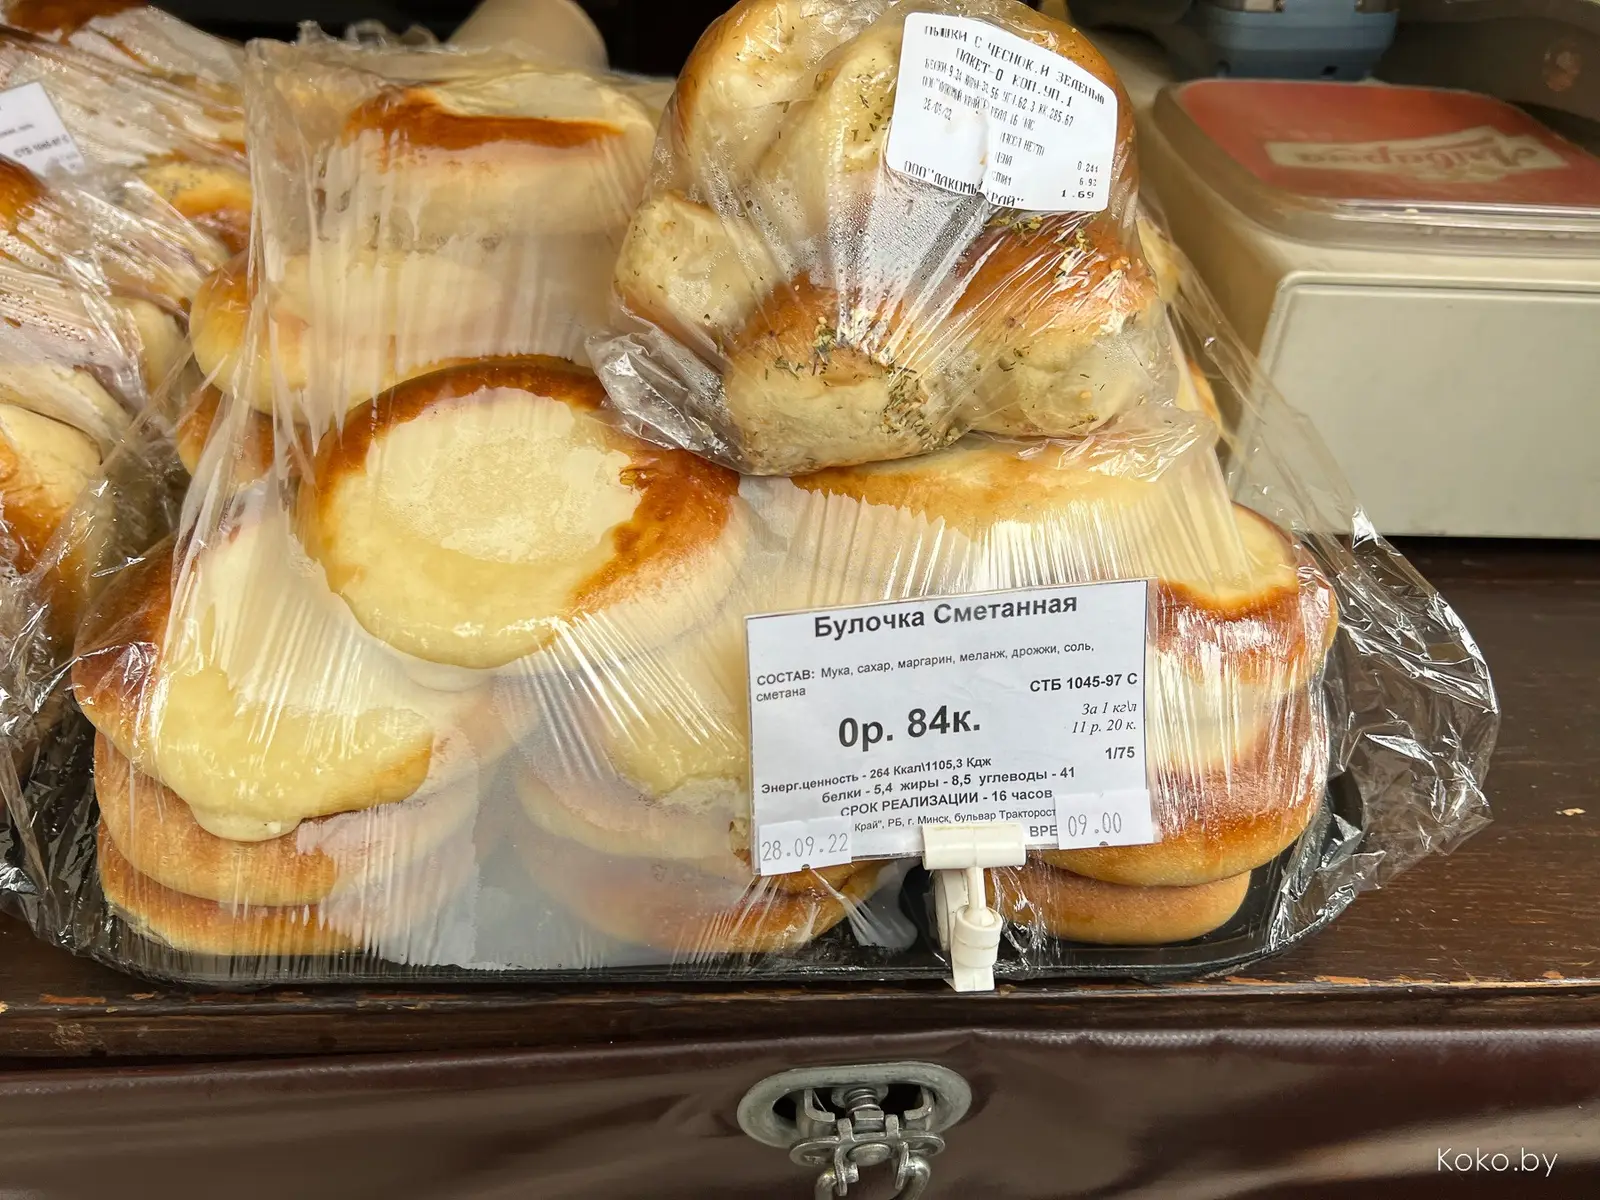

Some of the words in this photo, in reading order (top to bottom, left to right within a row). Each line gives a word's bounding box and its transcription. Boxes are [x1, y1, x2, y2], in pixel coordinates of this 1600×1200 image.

[924, 25, 968, 42] ПЫШКИ
[974, 35, 983, 49] С
[1056, 71, 1105, 105] ЗЕЛЕНЬЮ
[1061, 188, 1095, 199] 1.69
[814, 610, 925, 641] Булочка
[933, 596, 1078, 624] Сметанная
[756, 669, 815, 686] СОСТАВ:
[820, 667, 854, 680] Мука,
[857, 662, 894, 674] сахар,
[897, 654, 956, 669] маргарин,
[959, 650, 1008, 662] меланж,
[1011, 645, 1060, 658] дрожжи,
[1063, 641, 1094, 653] соль,
[756, 687, 806, 702] сметана
[1029, 678, 1062, 692] СТБ
[1066, 673, 1122, 690] 1045-97
[1126, 672, 1138, 685] С
[1081, 703, 1097, 715] За
[1102, 702, 1109, 715] 1
[1112, 701, 1137, 714] кг\л
[838, 717, 894, 752] 0р.
[906, 705, 981, 738] 84к.
[1071, 721, 1085, 735] 11
[1088, 722, 1102, 735] р.
[1106, 719, 1123, 732] 20
[1125, 720, 1137, 731] к.
[1105, 746, 1136, 760] 1/75
[761, 773, 859, 794] Энерг.ценность
[869, 767, 890, 779] 264
[893, 758, 963, 776] Ккал\1105,3
[966, 757, 992, 768] Кдж
[821, 789, 862, 803] белки
[873, 783, 893, 796] 5,4
[899, 778, 939, 793] жиры
[951, 774, 971, 787] 8,5
[978, 770, 1048, 787] углеводы
[1059, 766, 1076, 779] 41
[840, 801, 878, 817] СРОК
[881, 791, 979, 812] РЕАЛИЗАЦИИ
[991, 790, 1007, 802] 16
[1011, 789, 1053, 801] часов
[854, 819, 885, 833] Край",
[887, 817, 905, 828] РБ,
[907, 817, 915, 826] г.
[917, 814, 952, 825] Минск,
[954, 810, 997, 823] бульвар
[1067, 812, 1122, 837] 09.00
[761, 832, 849, 862] 28.09.22
